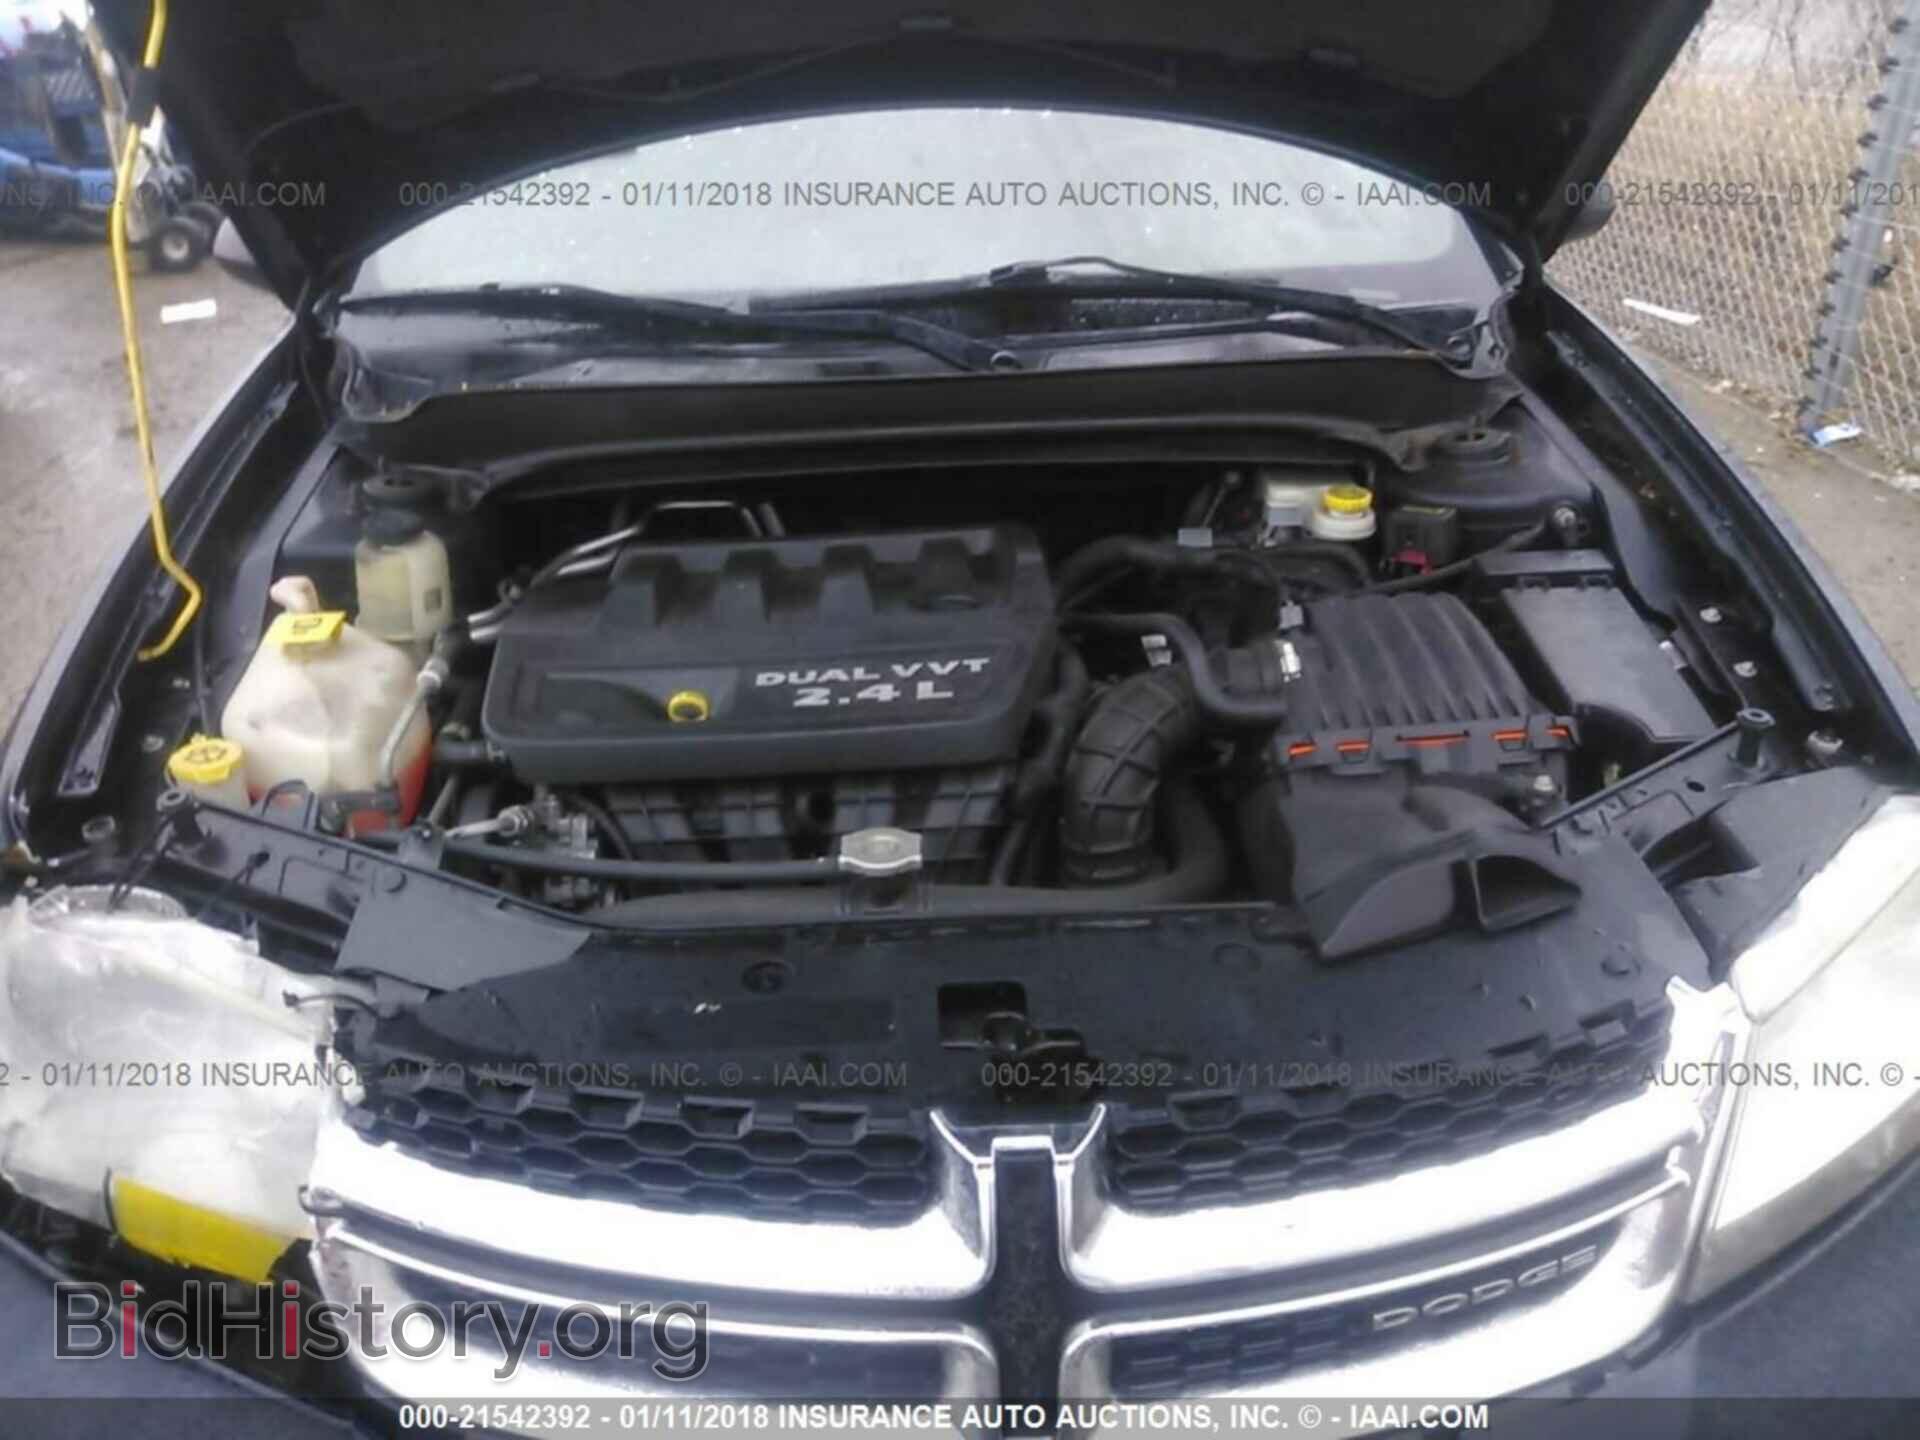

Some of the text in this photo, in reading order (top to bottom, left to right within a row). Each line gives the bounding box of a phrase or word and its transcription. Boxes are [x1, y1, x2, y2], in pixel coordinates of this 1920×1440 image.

[755, 658, 990, 687] DUAL VVT
[1373, 1245, 1597, 1331] DODGE
